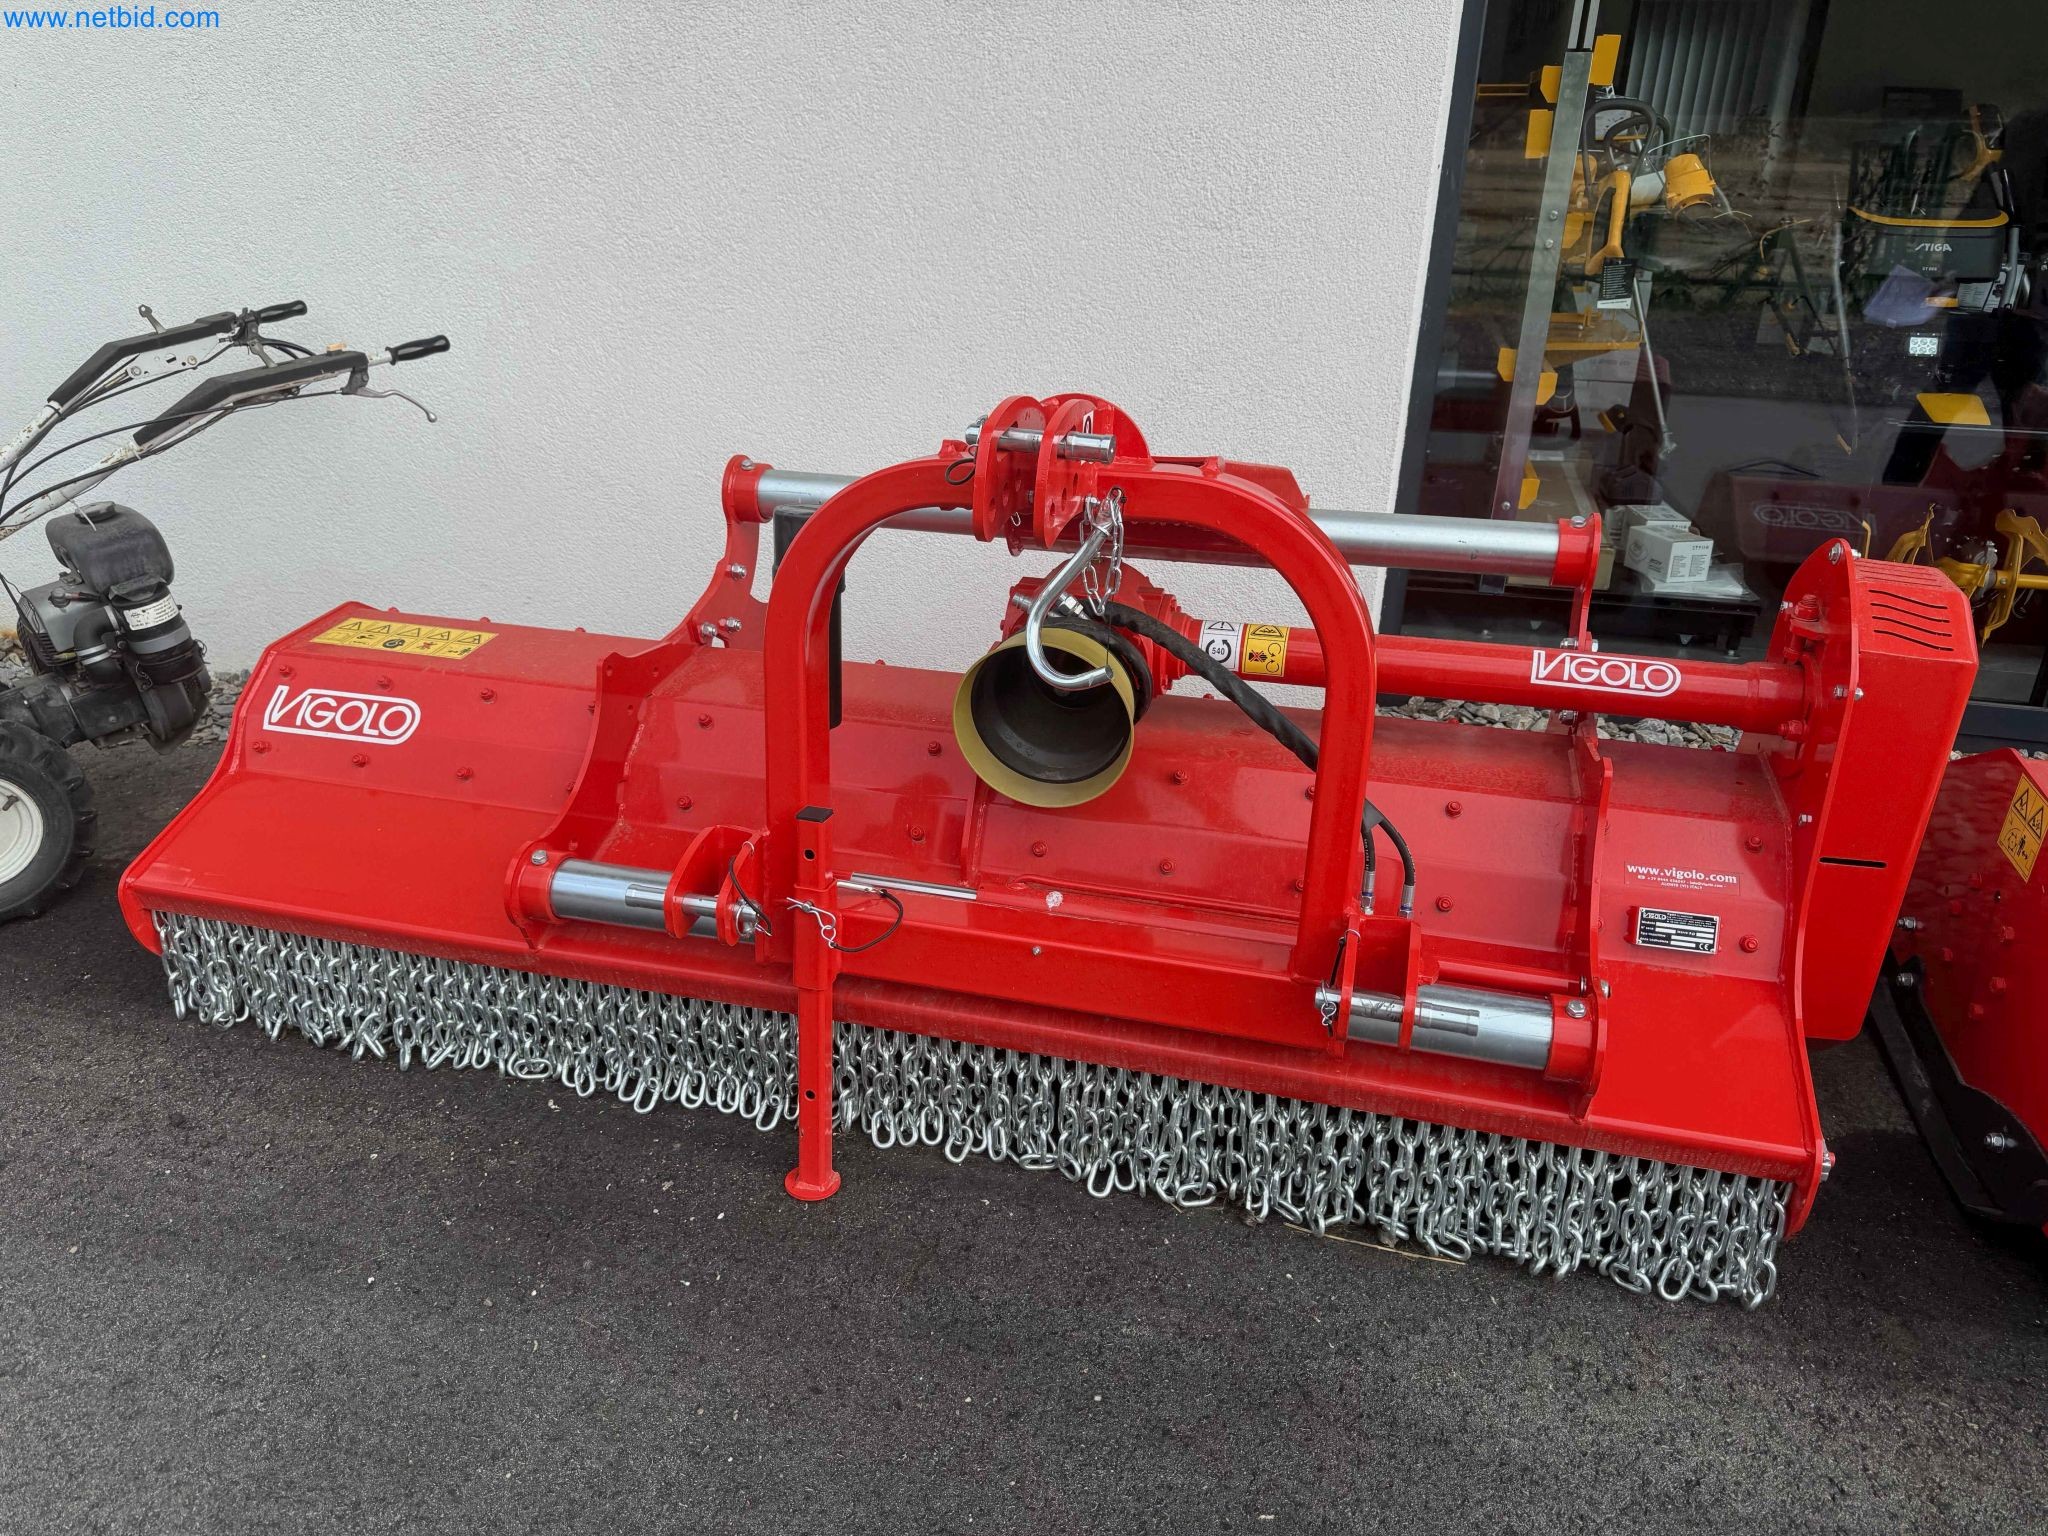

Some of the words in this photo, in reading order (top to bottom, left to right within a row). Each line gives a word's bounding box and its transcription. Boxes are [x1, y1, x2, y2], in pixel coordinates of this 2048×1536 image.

[1915, 243, 1952, 252] STIGA
[1211, 647, 1225, 656] 540
[1531, 650, 1680, 695] VIGOLO
[264, 685, 419, 742] VIGOLO
[1627, 865, 1737, 884] www.vigolo.com
[1642, 912, 1667, 921] VIGOLO
